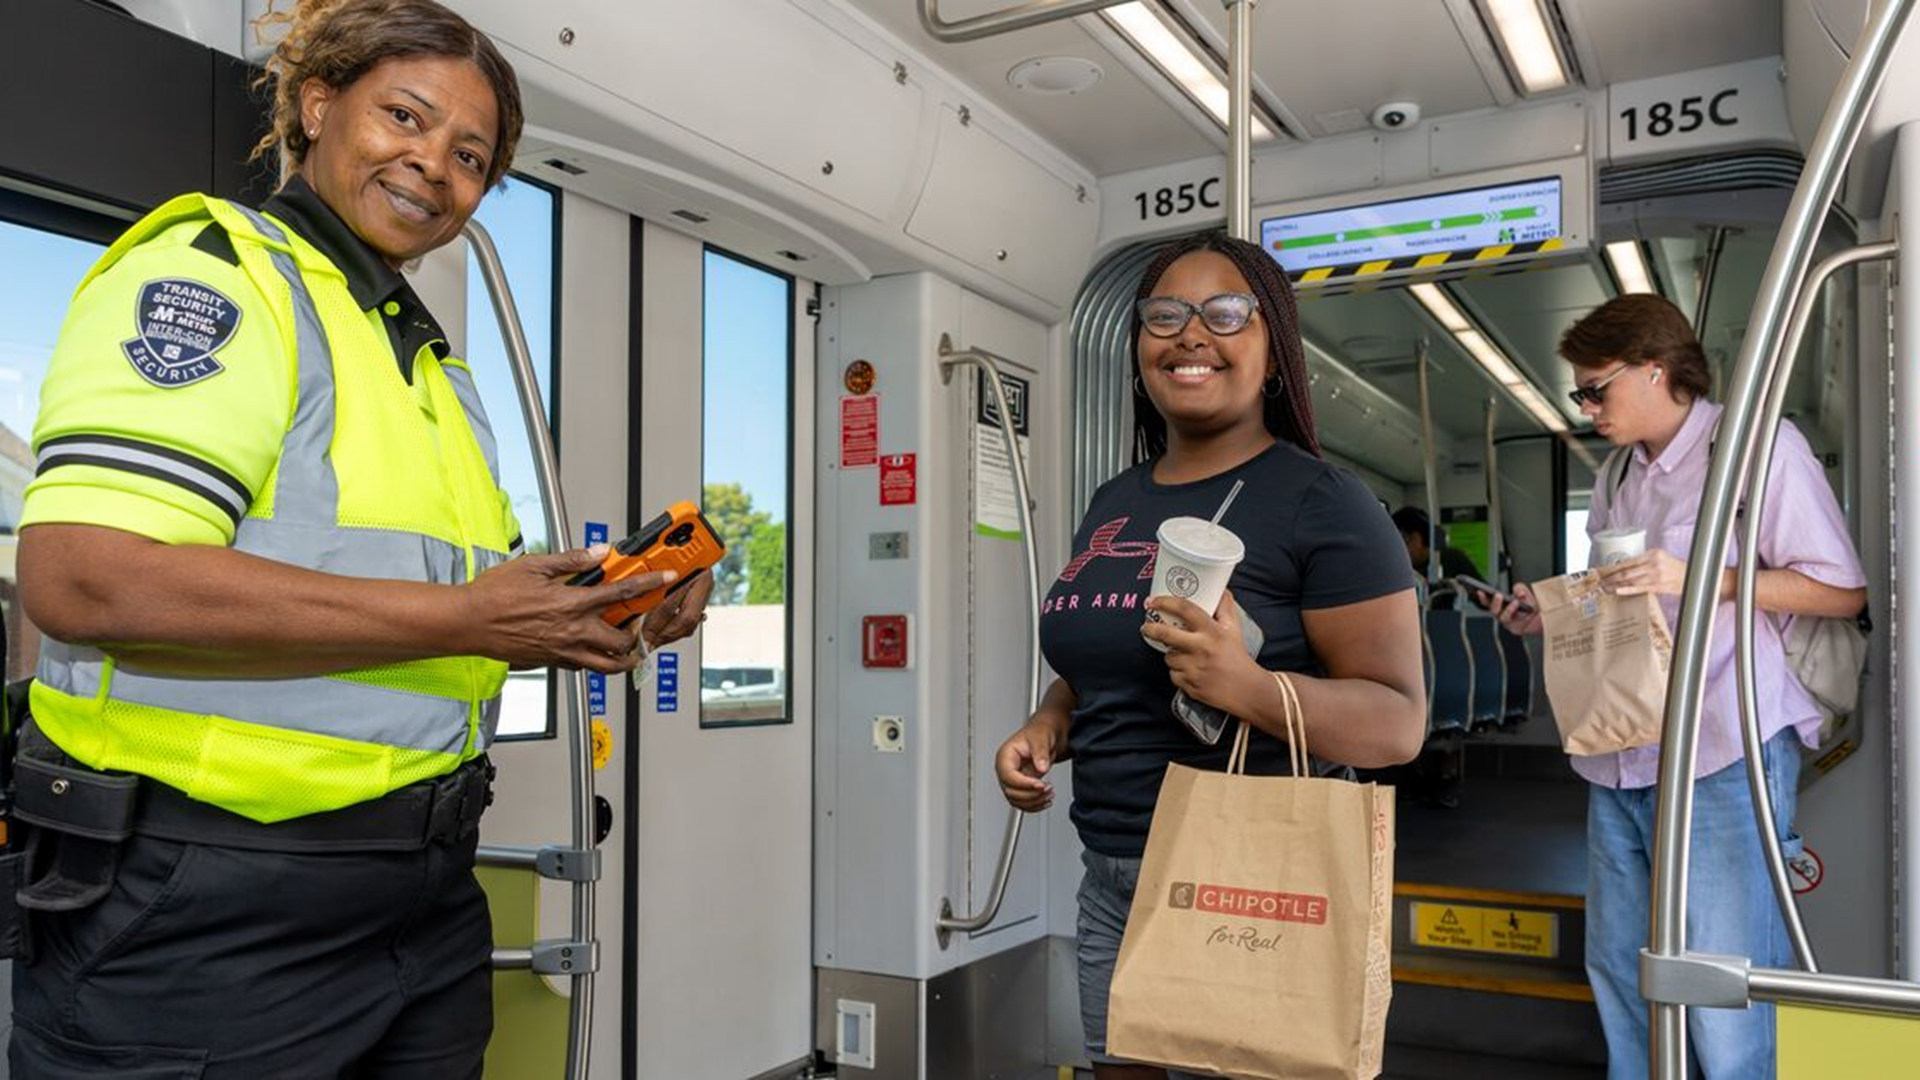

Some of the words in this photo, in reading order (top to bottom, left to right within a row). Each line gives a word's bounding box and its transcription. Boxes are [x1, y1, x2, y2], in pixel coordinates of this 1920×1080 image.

[1620, 88, 1738, 141] 185C
[1135, 177, 1220, 220] 185C
[1521, 229, 1556, 241] METRO
[152, 292, 226, 320] SECURITY
[162, 282, 225, 307] TRANSIT
[177, 317, 217, 335] METRO
[185, 311, 216, 325] VALLEY
[132, 347, 209, 380] SECURITY
[1202, 890, 1321, 919] CHIPOTLE
[1206, 925, 1235, 945] for
[1236, 926, 1282, 952] Real
[1427, 932, 1447, 942] Your
[1450, 935, 1472, 946] Step
[1434, 924, 1466, 935] Watch
